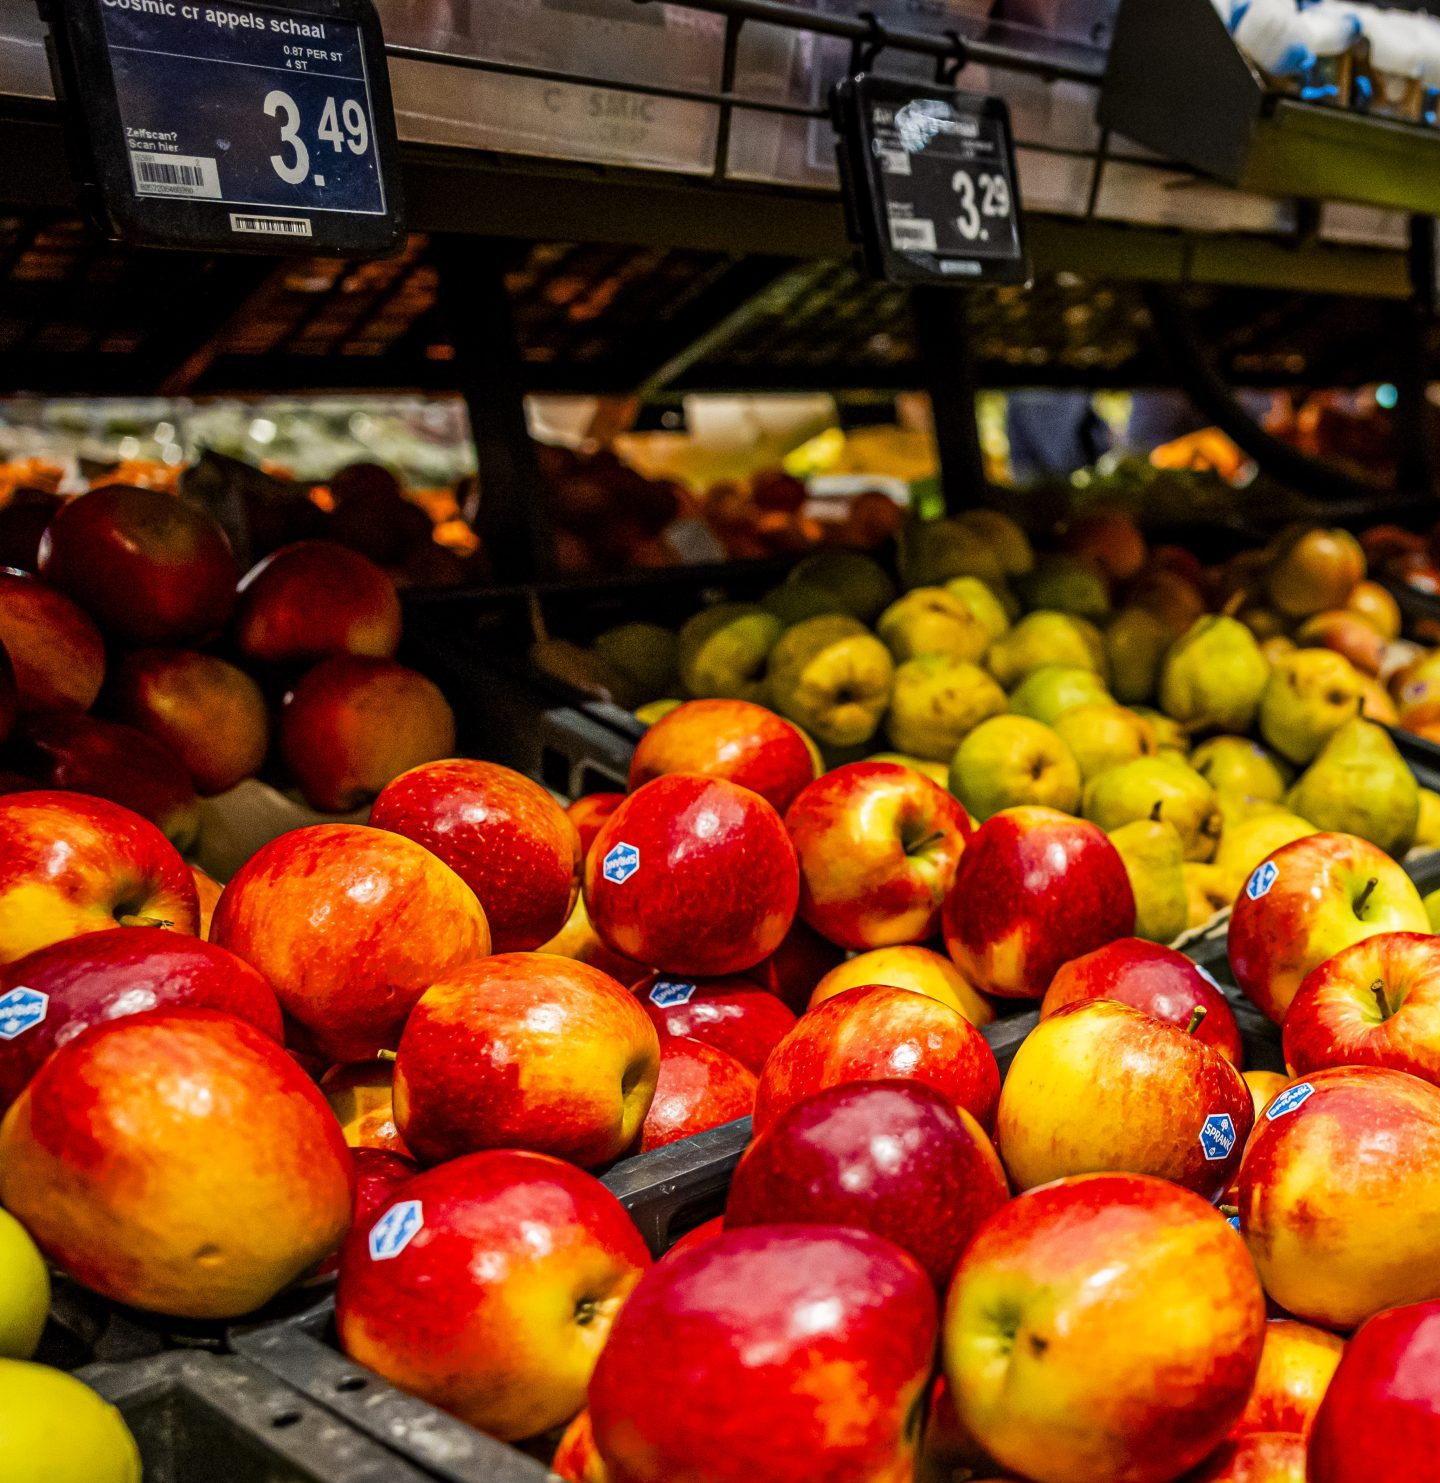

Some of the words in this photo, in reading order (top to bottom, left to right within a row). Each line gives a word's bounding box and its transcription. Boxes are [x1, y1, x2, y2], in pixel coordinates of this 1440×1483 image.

[182, 5, 199, 20] cr
[205, 9, 265, 30] appels
[270, 18, 326, 39] schaal
[283, 45, 303, 57] 0.87
[306, 48, 328, 60] PER
[330, 51, 343, 62] ST
[286, 59, 292, 68] 4
[295, 60, 308, 70] ST
[126, 127, 178, 141] Zelfscan?
[128, 138, 156, 150] Scan
[158, 142, 179, 152] hier
[1269, 1085, 1311, 1116] SPRANK
[1204, 1123, 1232, 1151] SPRANK
